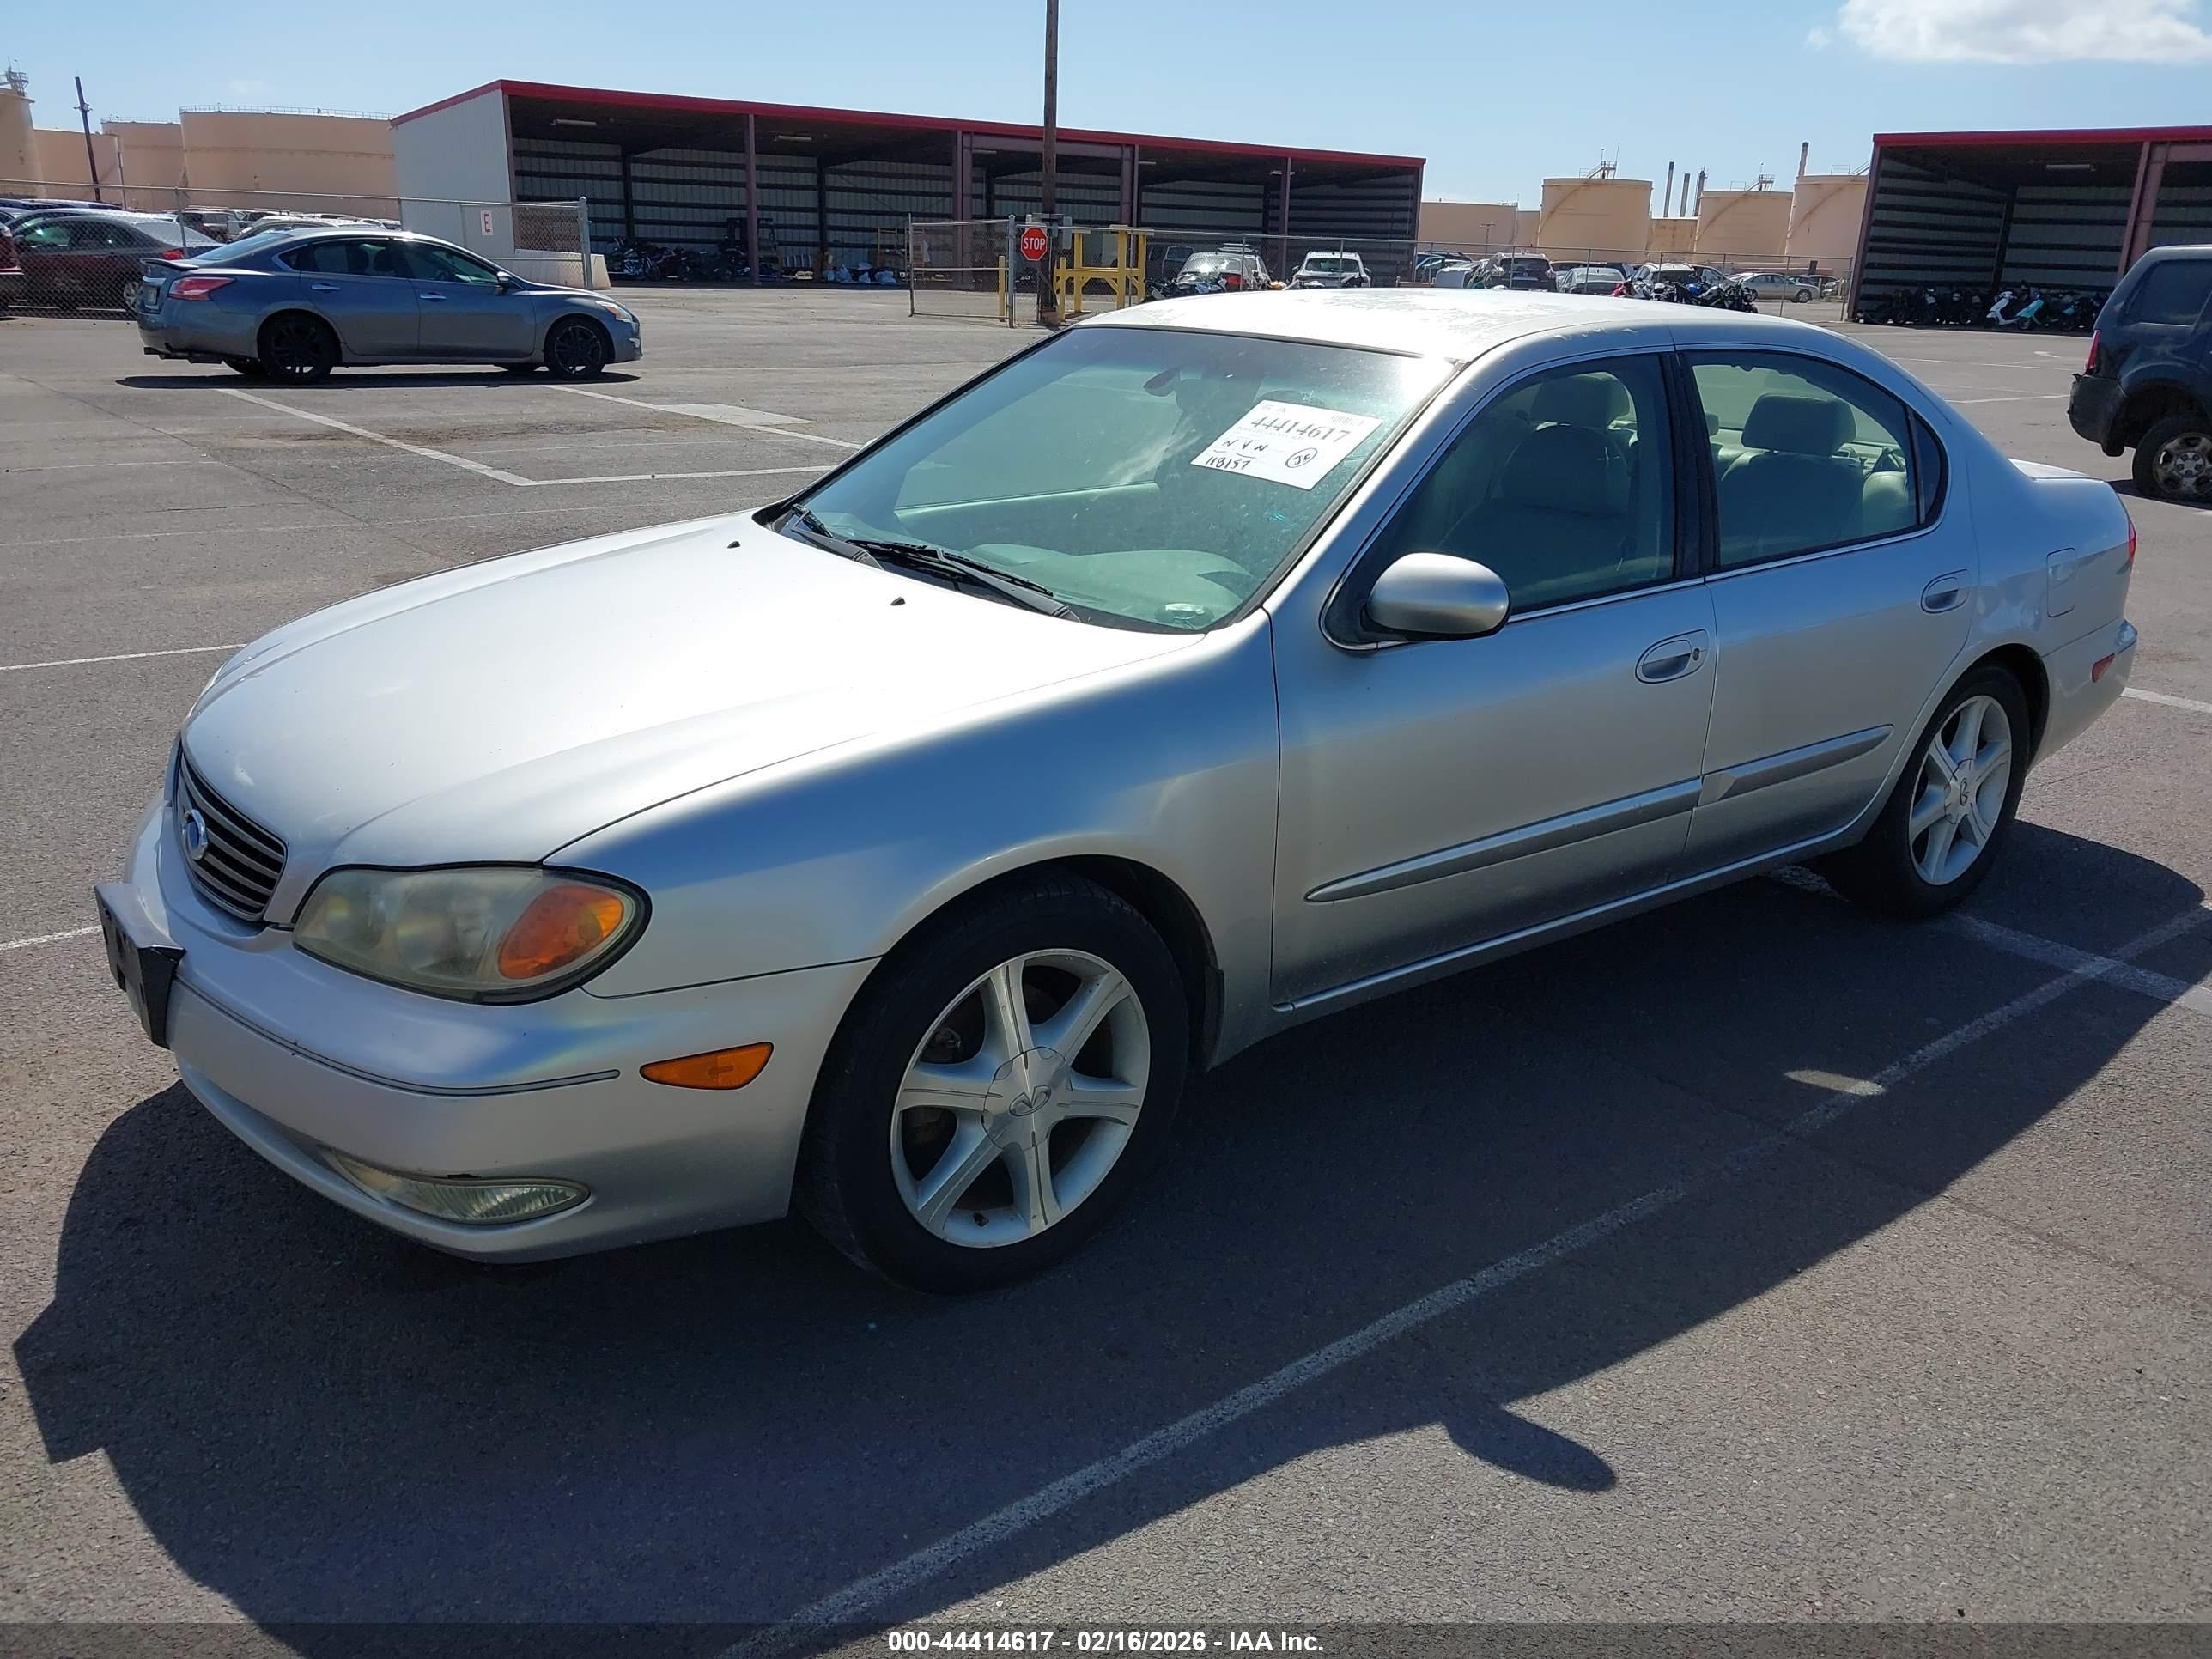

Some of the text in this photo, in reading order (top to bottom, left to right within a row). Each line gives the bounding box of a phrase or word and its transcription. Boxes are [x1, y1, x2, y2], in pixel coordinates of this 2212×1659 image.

[483, 213, 491, 234] E
[1023, 237, 1046, 251] STOP
[1250, 415, 1352, 443] 44414617
